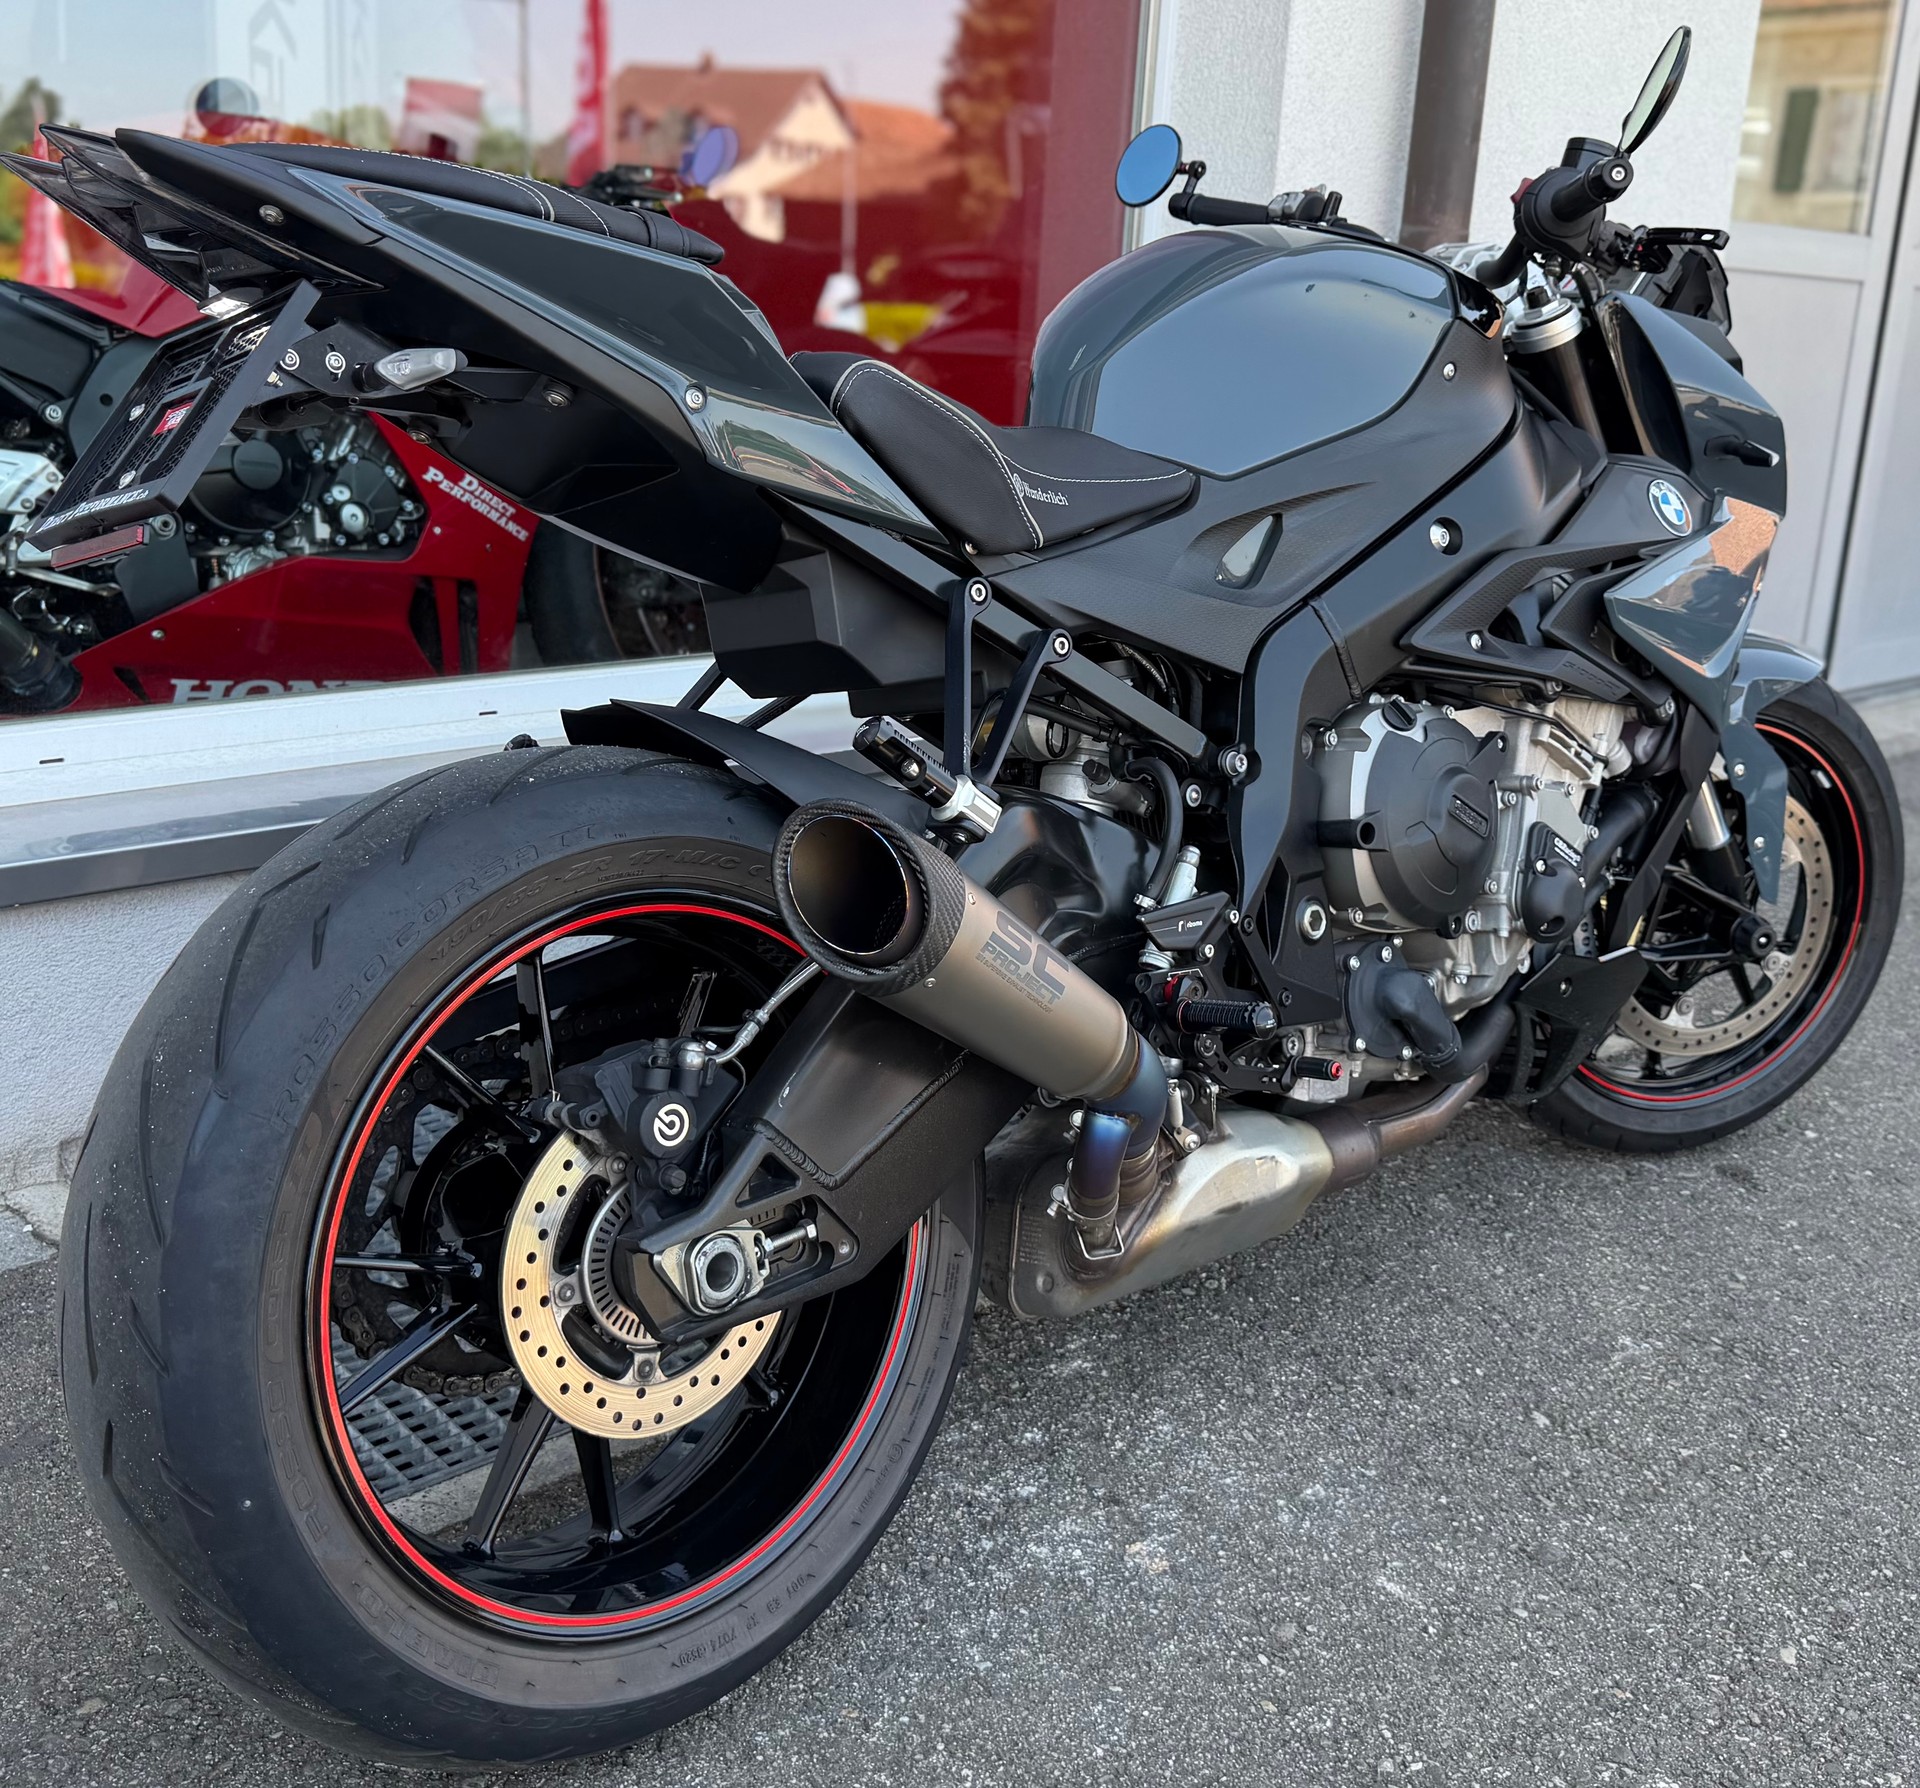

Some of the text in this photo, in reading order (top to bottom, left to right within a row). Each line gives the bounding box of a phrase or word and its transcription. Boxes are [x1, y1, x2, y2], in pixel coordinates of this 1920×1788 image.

[422, 466, 529, 541] PERFORMANCE
[459, 473, 516, 517] DIRECT
[980, 941, 1061, 1005] PROJECT
[996, 910, 1070, 996] SC
